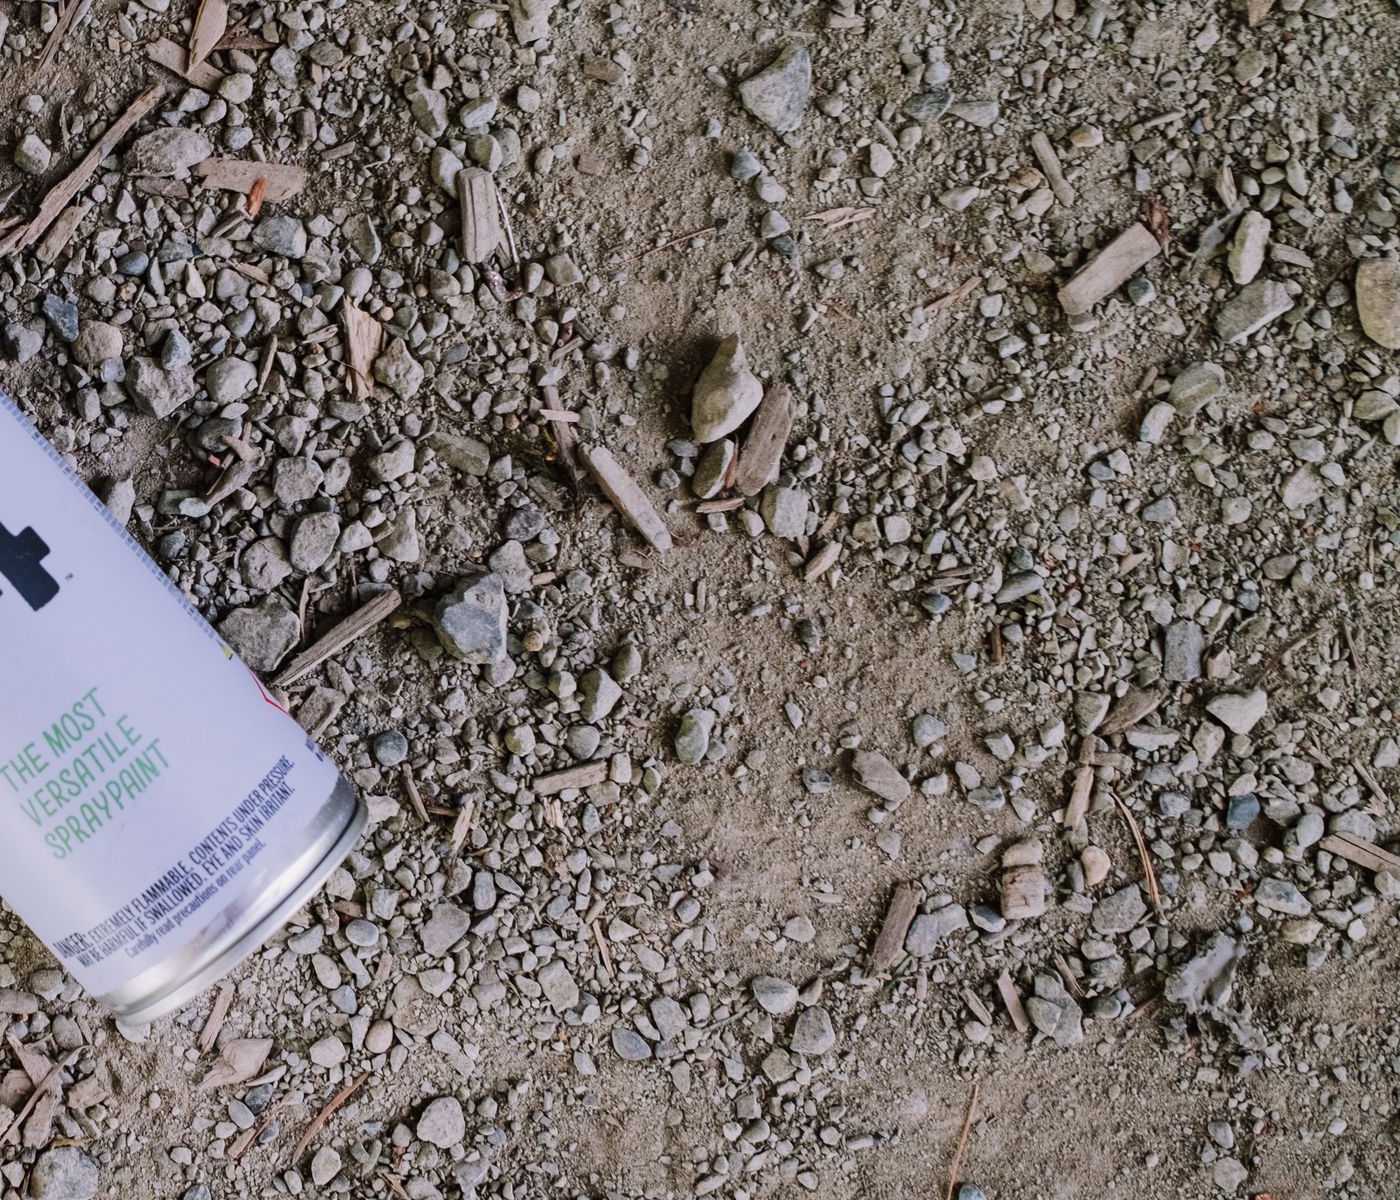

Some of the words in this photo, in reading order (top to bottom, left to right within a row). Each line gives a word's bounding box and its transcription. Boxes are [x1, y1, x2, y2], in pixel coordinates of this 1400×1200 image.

[20, 714, 142, 826] VERSATILE
[42, 686, 106, 758] MOST
[44, 738, 169, 859] SPRAYPAINT
[88, 905, 135, 943] EXTREMELY
[131, 861, 194, 912] FLAMMABLE.
[188, 817, 238, 865] CONTENTS
[232, 789, 265, 822] UNDER
[258, 755, 295, 797] PRESSURE.
[88, 948, 104, 962] BE
[101, 925, 140, 957] HARMFUL
[134, 917, 148, 932] IF
[143, 872, 207, 925] SWALLOWED.
[202, 853, 225, 877] EYE
[220, 835, 244, 862] AND
[239, 815, 264, 841] SKIN
[259, 781, 296, 821] IRRITANT.
[124, 934, 159, 958] Carefully
[155, 917, 175, 938] read
[172, 885, 218, 926] precautions
[216, 873, 229, 888] on
[226, 859, 245, 879] rear
[242, 837, 267, 866] panel.
